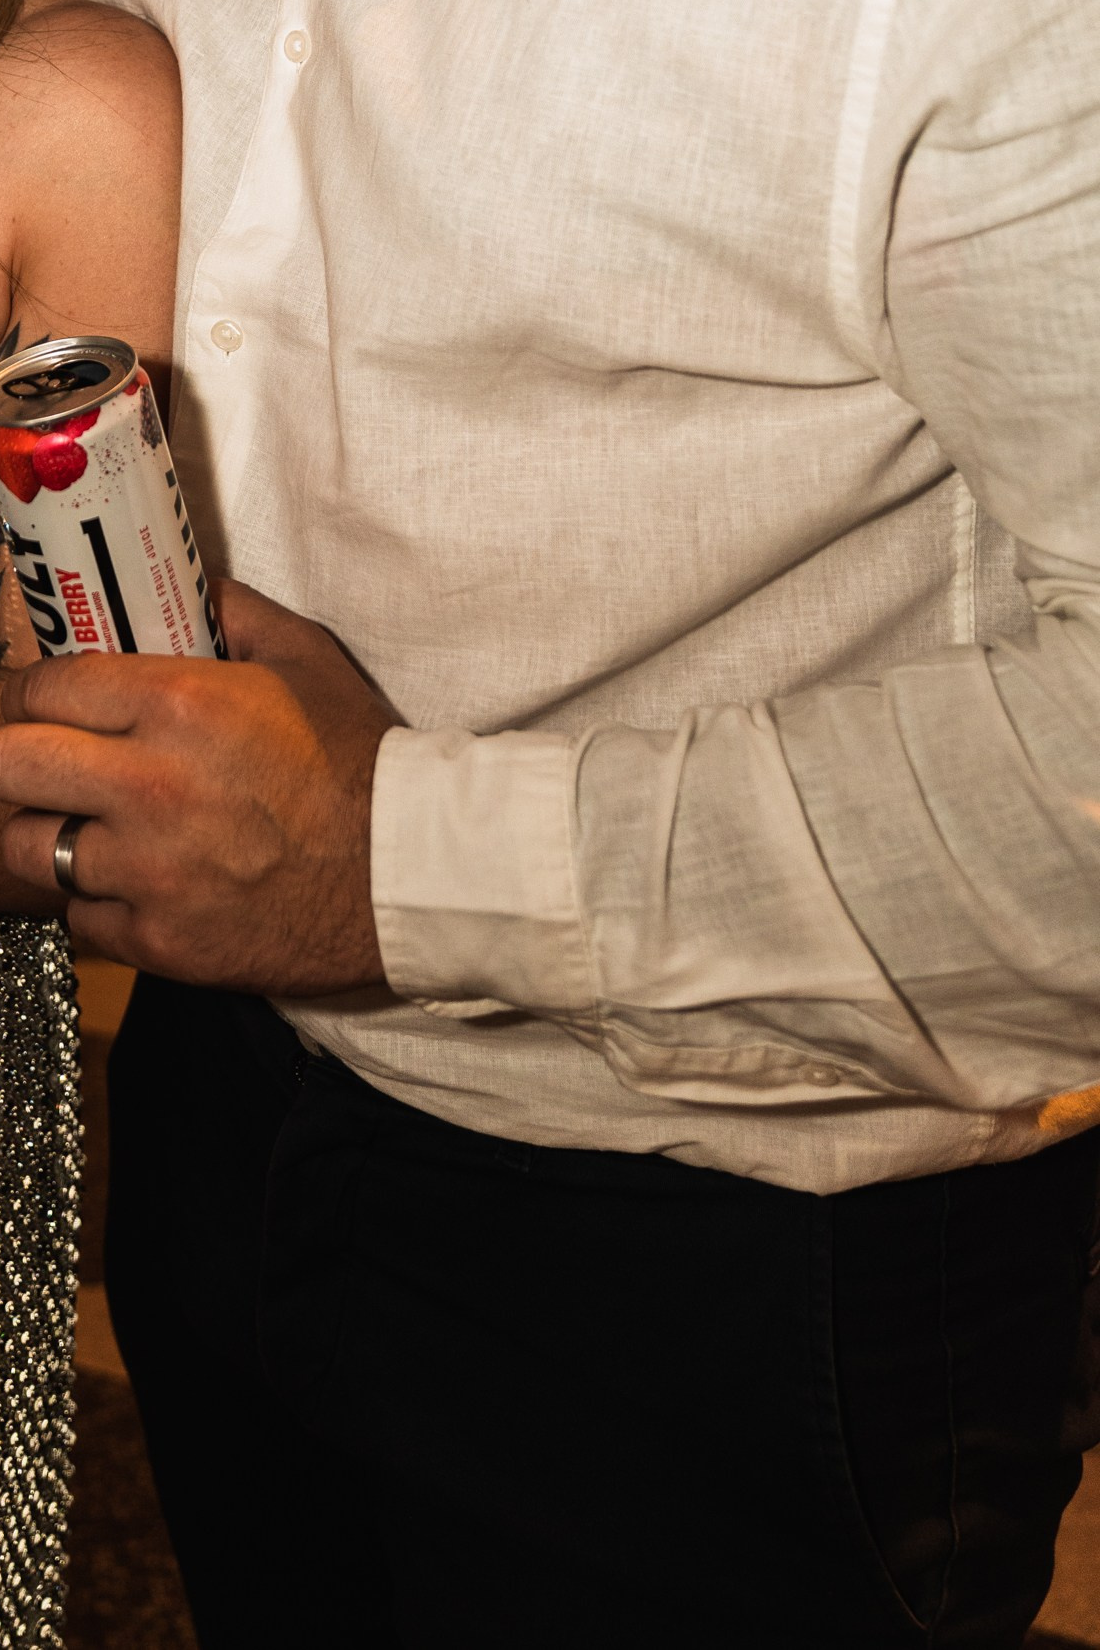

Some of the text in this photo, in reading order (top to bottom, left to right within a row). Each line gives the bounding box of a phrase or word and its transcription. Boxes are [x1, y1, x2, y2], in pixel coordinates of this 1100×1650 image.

[139, 524, 157, 559] JUICE
[3, 522, 74, 657] ULY
[150, 563, 167, 597] FRUIT
[164, 556, 187, 621] CONCENTRATE
[55, 567, 100, 643] BERRY
[91, 590, 106, 618] FLAVORS
[160, 598, 176, 630] REAL
[99, 616, 114, 644] NATURAL
[183, 622, 196, 649] FROM
